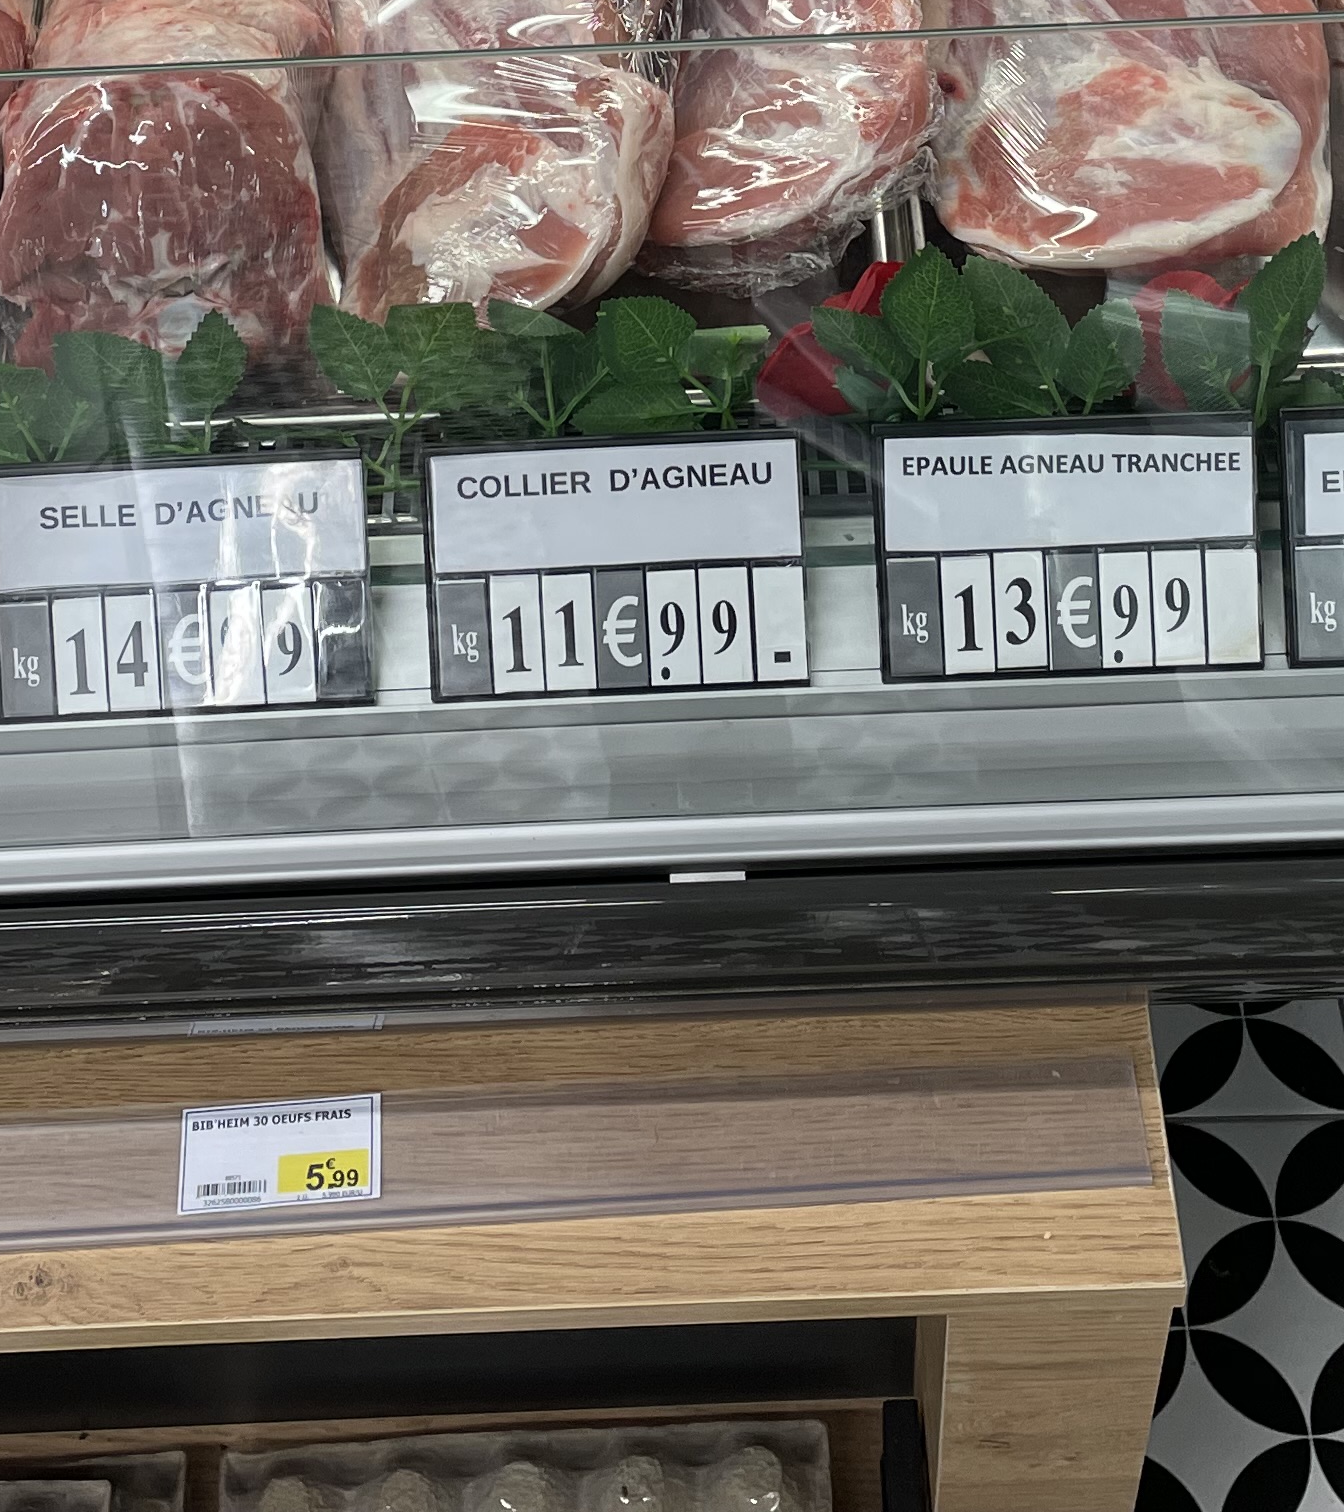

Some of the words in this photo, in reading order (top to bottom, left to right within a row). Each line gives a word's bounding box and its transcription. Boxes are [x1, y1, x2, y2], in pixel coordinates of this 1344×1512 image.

[456, 470, 593, 500] COLLIER
[609, 461, 774, 492] D'AGNEAU
[902, 454, 993, 477] EPAULE
[999, 453, 1105, 476] AGNEAU
[1112, 451, 1241, 474] TRANCHEE
[39, 503, 137, 530] SELLE
[155, 491, 319, 526] D'AGNEU
[900, 604, 930, 644] kg
[1309, 592, 1338, 632] kg
[451, 624, 479, 664] kg
[12, 647, 40, 687] kg
[253, 1115, 269, 1127] 30
[271, 1112, 313, 1126] OEUFS
[315, 1108, 352, 1121] FRAIS
